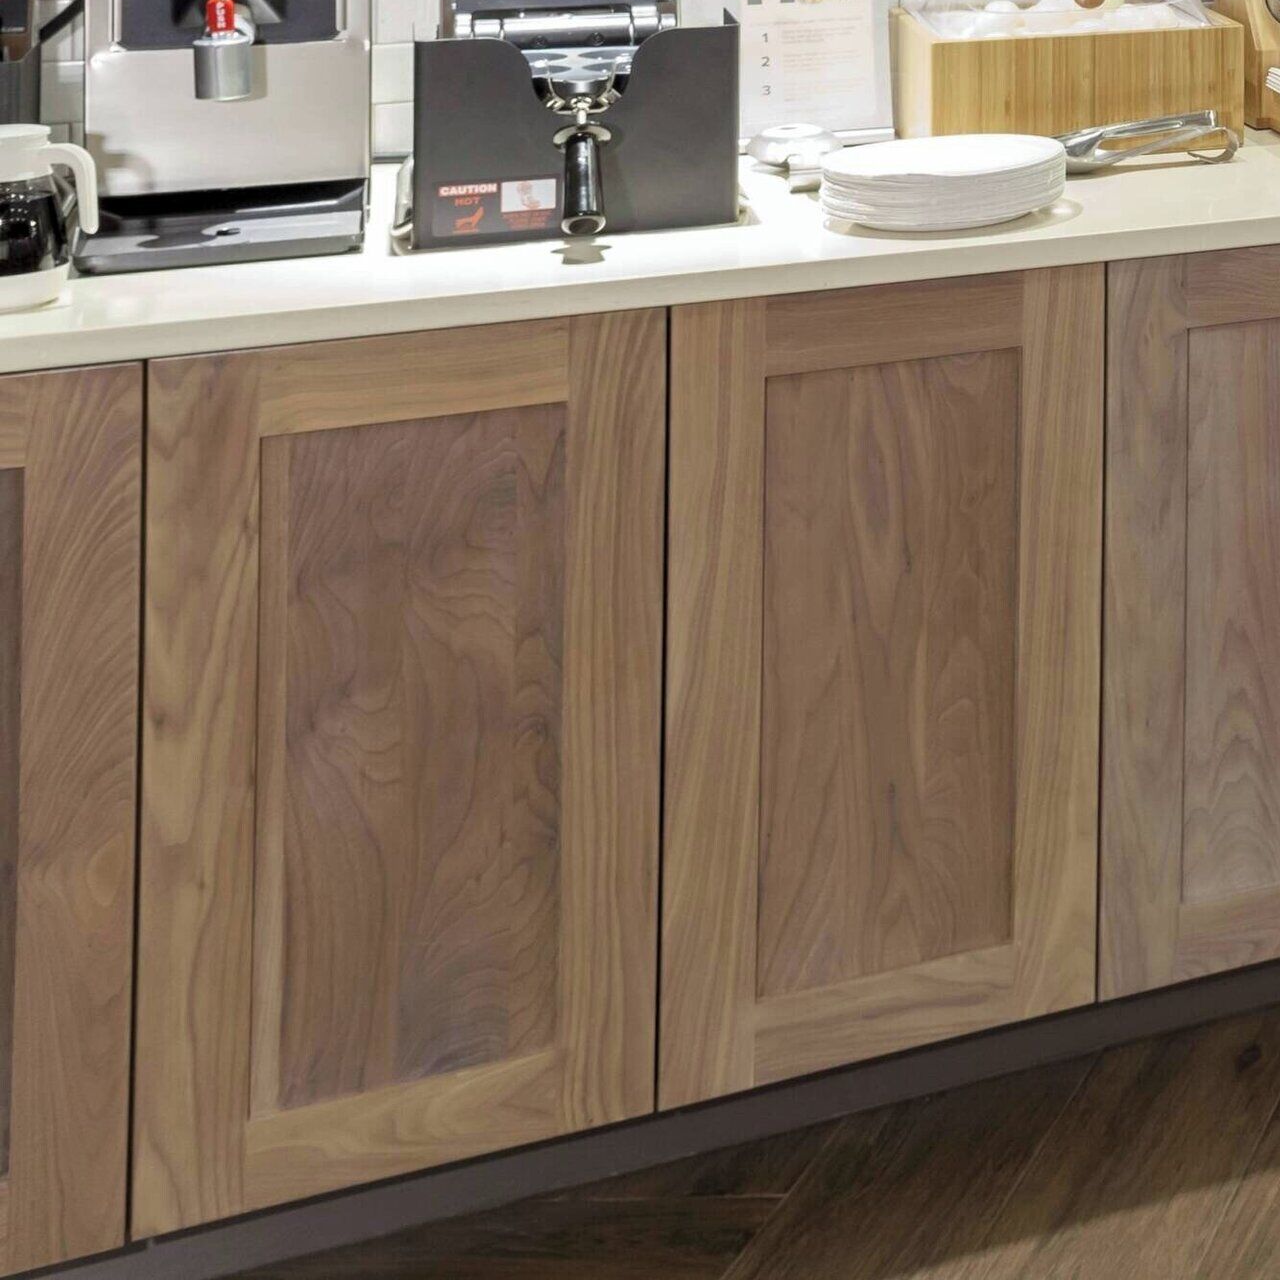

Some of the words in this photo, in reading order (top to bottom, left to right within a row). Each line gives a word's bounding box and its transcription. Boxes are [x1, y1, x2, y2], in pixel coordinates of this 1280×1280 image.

[761, 33, 769, 43] 1
[761, 56, 770, 67] 2
[762, 85, 772, 96] 3
[439, 183, 497, 196] CAUTION
[455, 197, 479, 206] HOT
